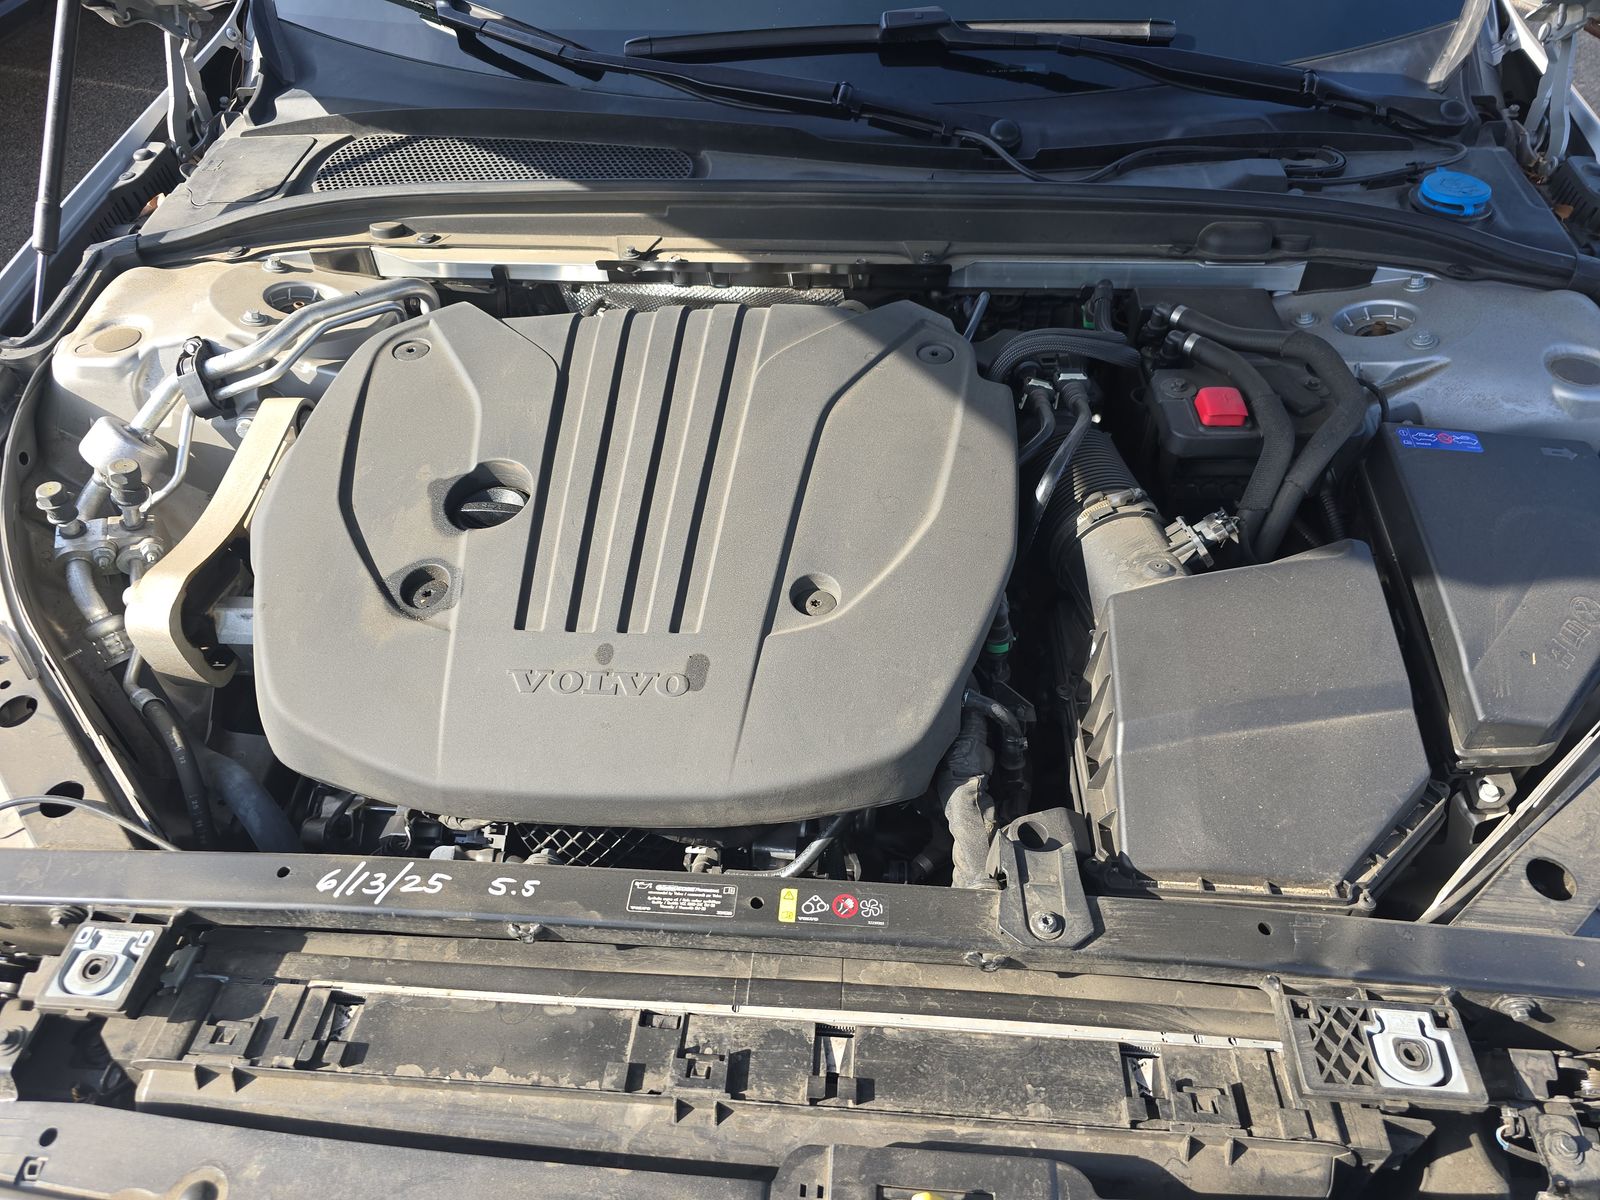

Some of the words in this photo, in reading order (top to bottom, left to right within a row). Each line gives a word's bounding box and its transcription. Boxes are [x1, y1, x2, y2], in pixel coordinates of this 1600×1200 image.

[505, 669, 690, 697] VOLVO
[315, 861, 453, 905] 6/13/25
[488, 877, 541, 897] 5.5
